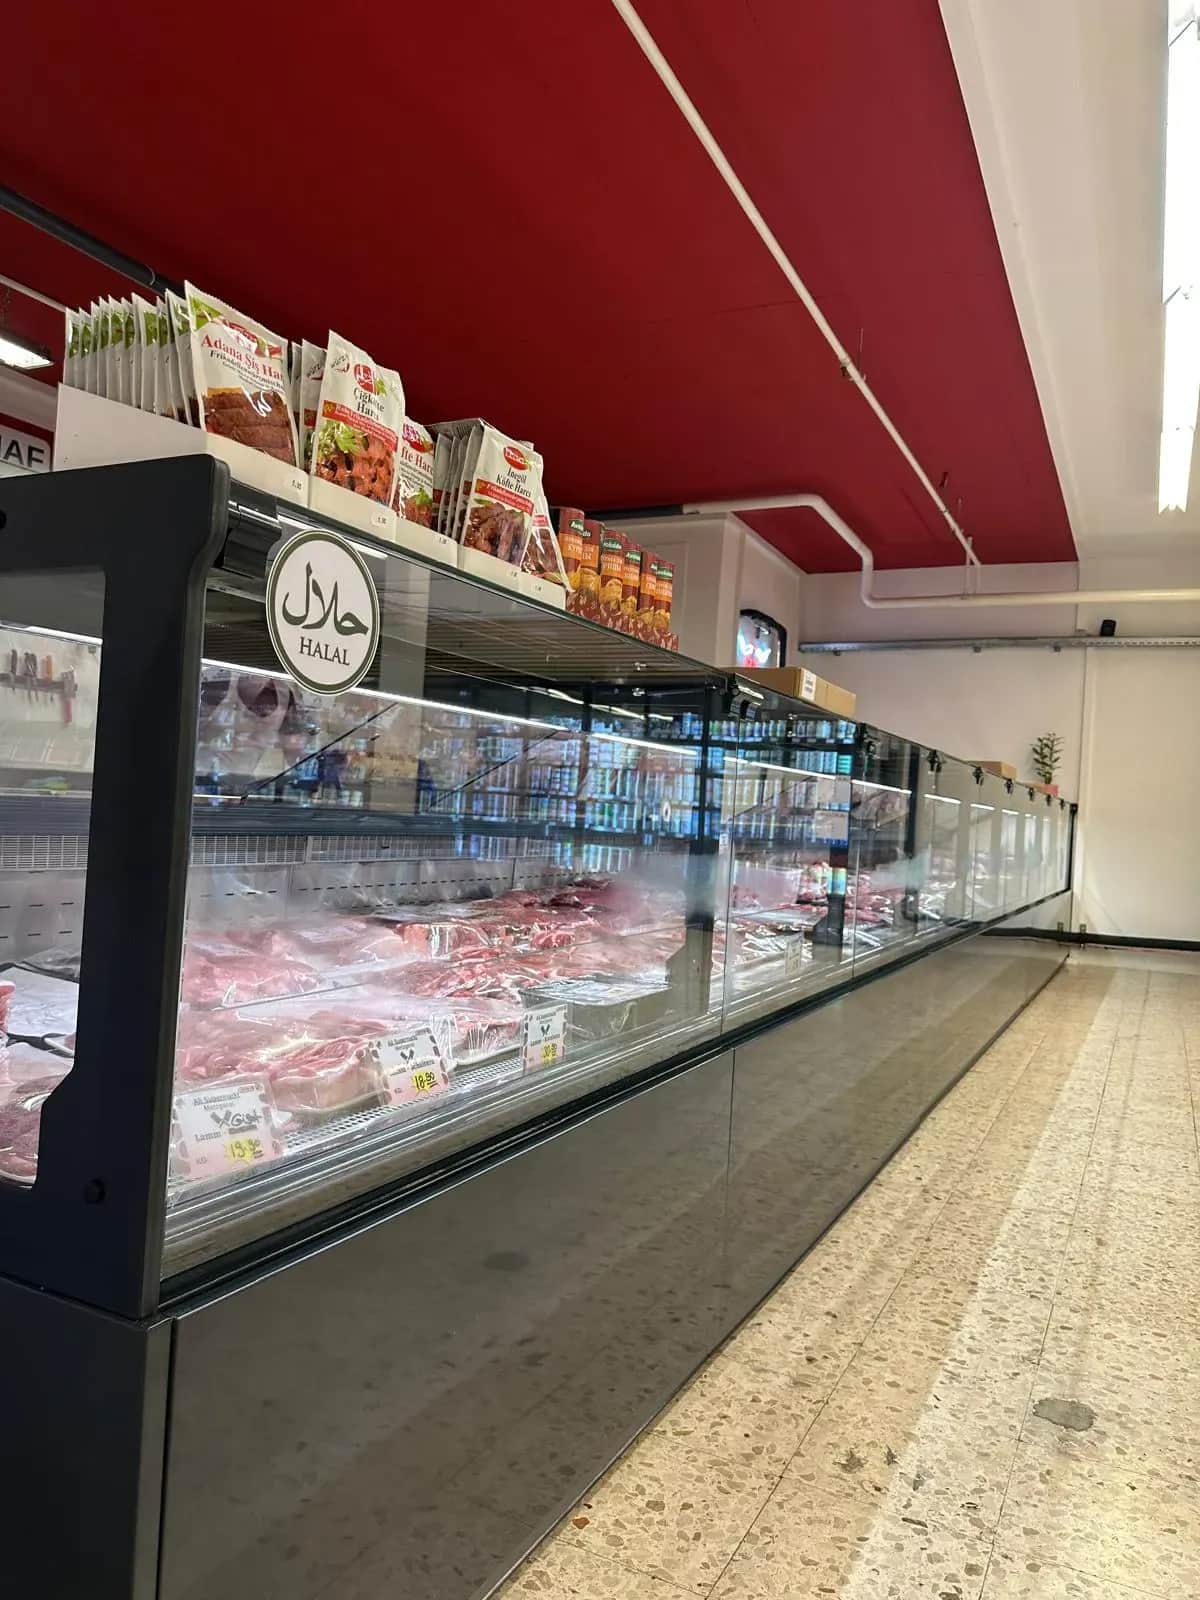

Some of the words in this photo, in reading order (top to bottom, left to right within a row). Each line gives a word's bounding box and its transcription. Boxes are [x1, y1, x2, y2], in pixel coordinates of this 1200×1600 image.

[201, 334, 243, 361] Adana
[353, 387, 385, 413] Çiğkte
[0, 435, 45, 468] AF
[282, 561, 369, 636] حلال
[300, 636, 350, 666] HALAL
[414, 1071, 435, 1090] 18.90
[194, 1131, 221, 1142] Lamm
